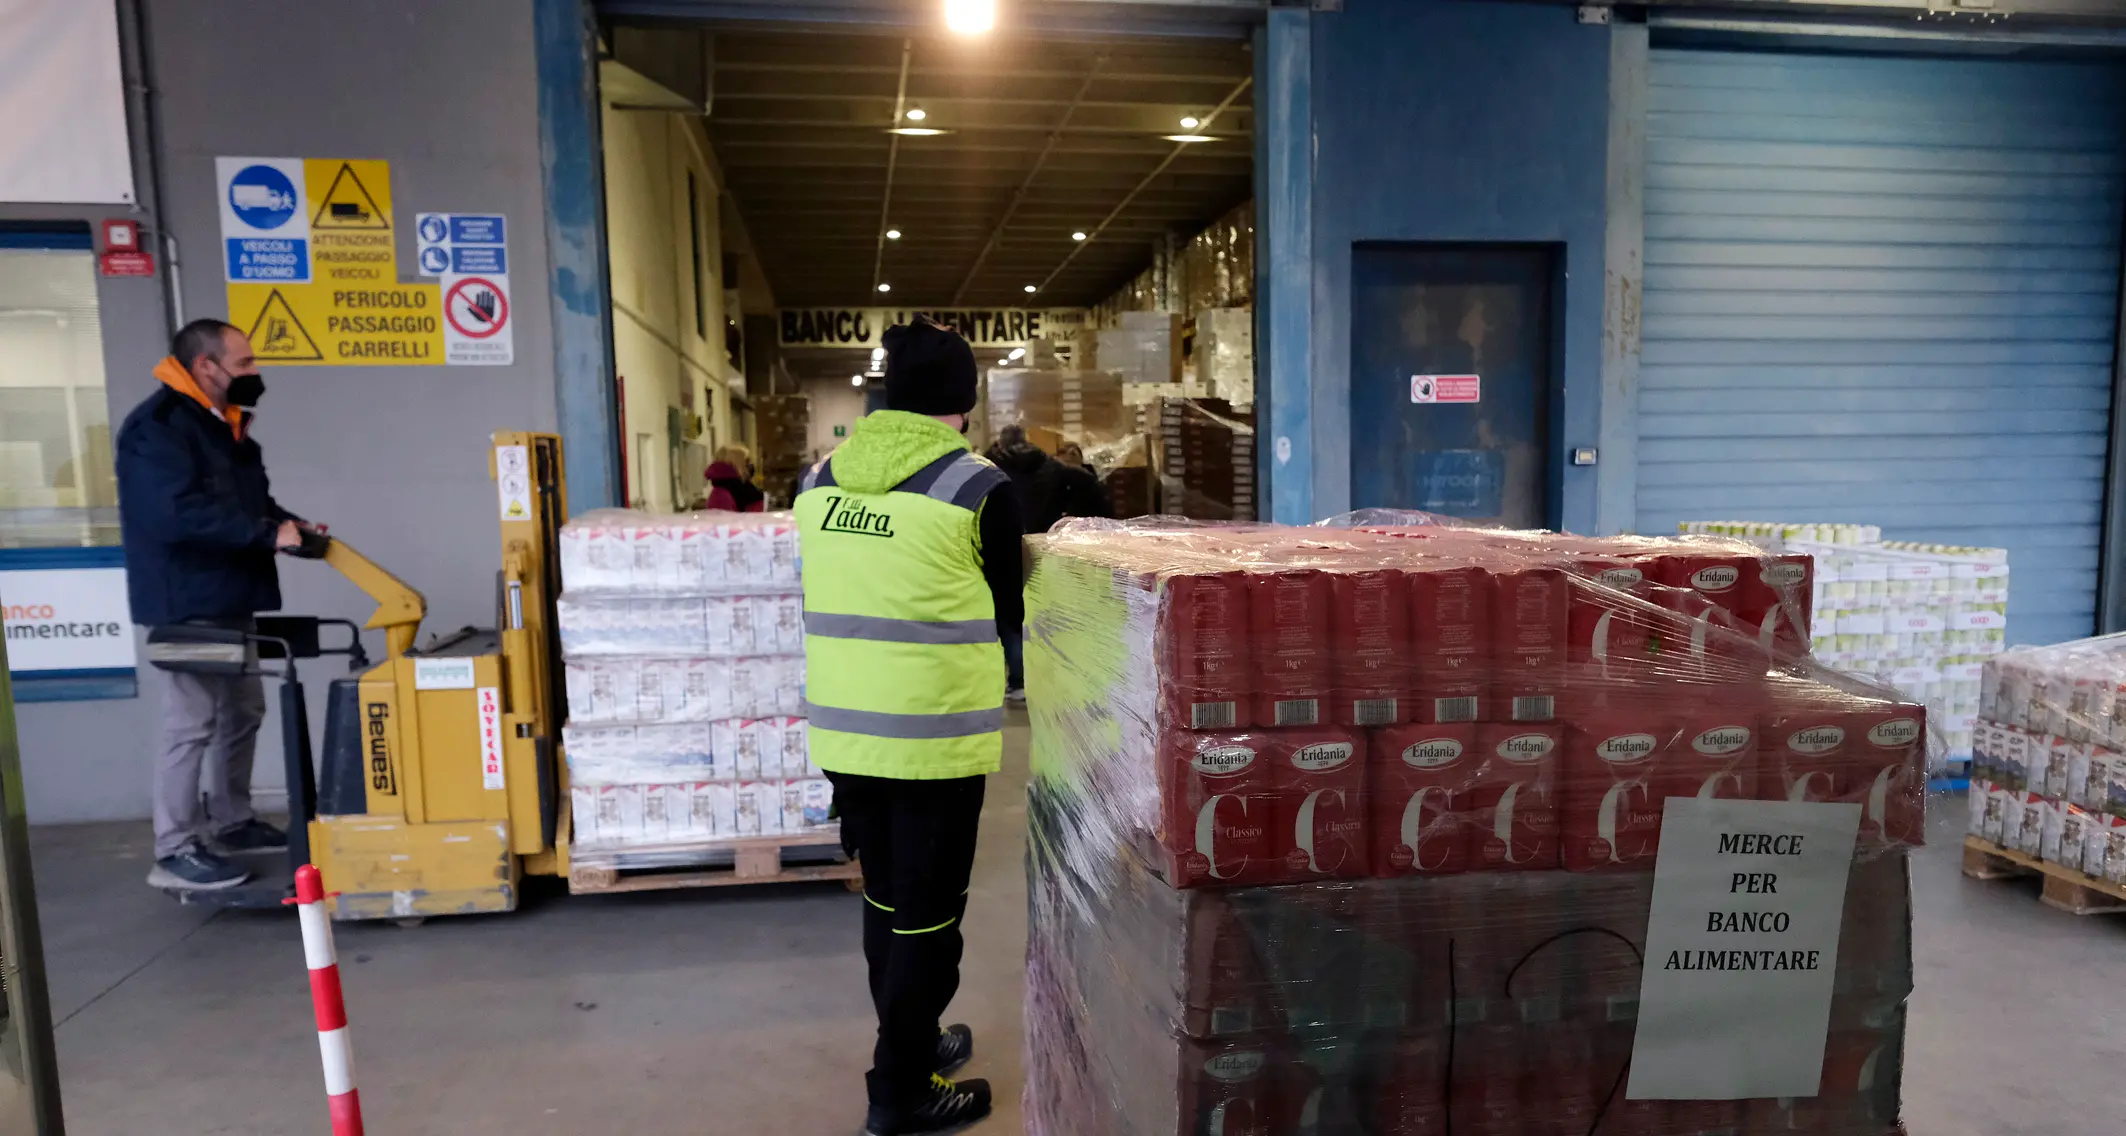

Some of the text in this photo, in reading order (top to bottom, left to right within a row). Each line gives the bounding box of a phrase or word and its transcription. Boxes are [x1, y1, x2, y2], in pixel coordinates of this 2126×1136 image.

[240, 239, 294, 252] VEICOLI
[312, 235, 391, 246] ATTENZIONE
[239, 253, 298, 265] A PASSO
[315, 251, 391, 263] PASSAGGIO
[242, 266, 295, 279] D'UOMO
[329, 267, 381, 280] VEICOLI
[333, 290, 427, 309] PERICOLO
[327, 315, 436, 334] PASSAGGIO
[780, 310, 871, 343] BANCO
[338, 340, 430, 358] CARRELLI
[820, 496, 894, 538] Zadra
[1700, 571, 1734, 582] Eridania
[1702, 732, 1744, 746] Eridania
[1798, 731, 1838, 745] Eridania
[367, 703, 389, 790] samag
[1412, 744, 1455, 758] Eridania
[1607, 739, 1650, 753] Eridania
[1201, 751, 1247, 765] Eridania
[1301, 747, 1346, 762] Eridania
[1226, 824, 1262, 838] Classico
[1717, 833, 1804, 856] MERCE
[1730, 873, 1778, 894] PER
[1706, 911, 1790, 933] BANCO
[1664, 950, 1820, 971] ALIMENTARE
